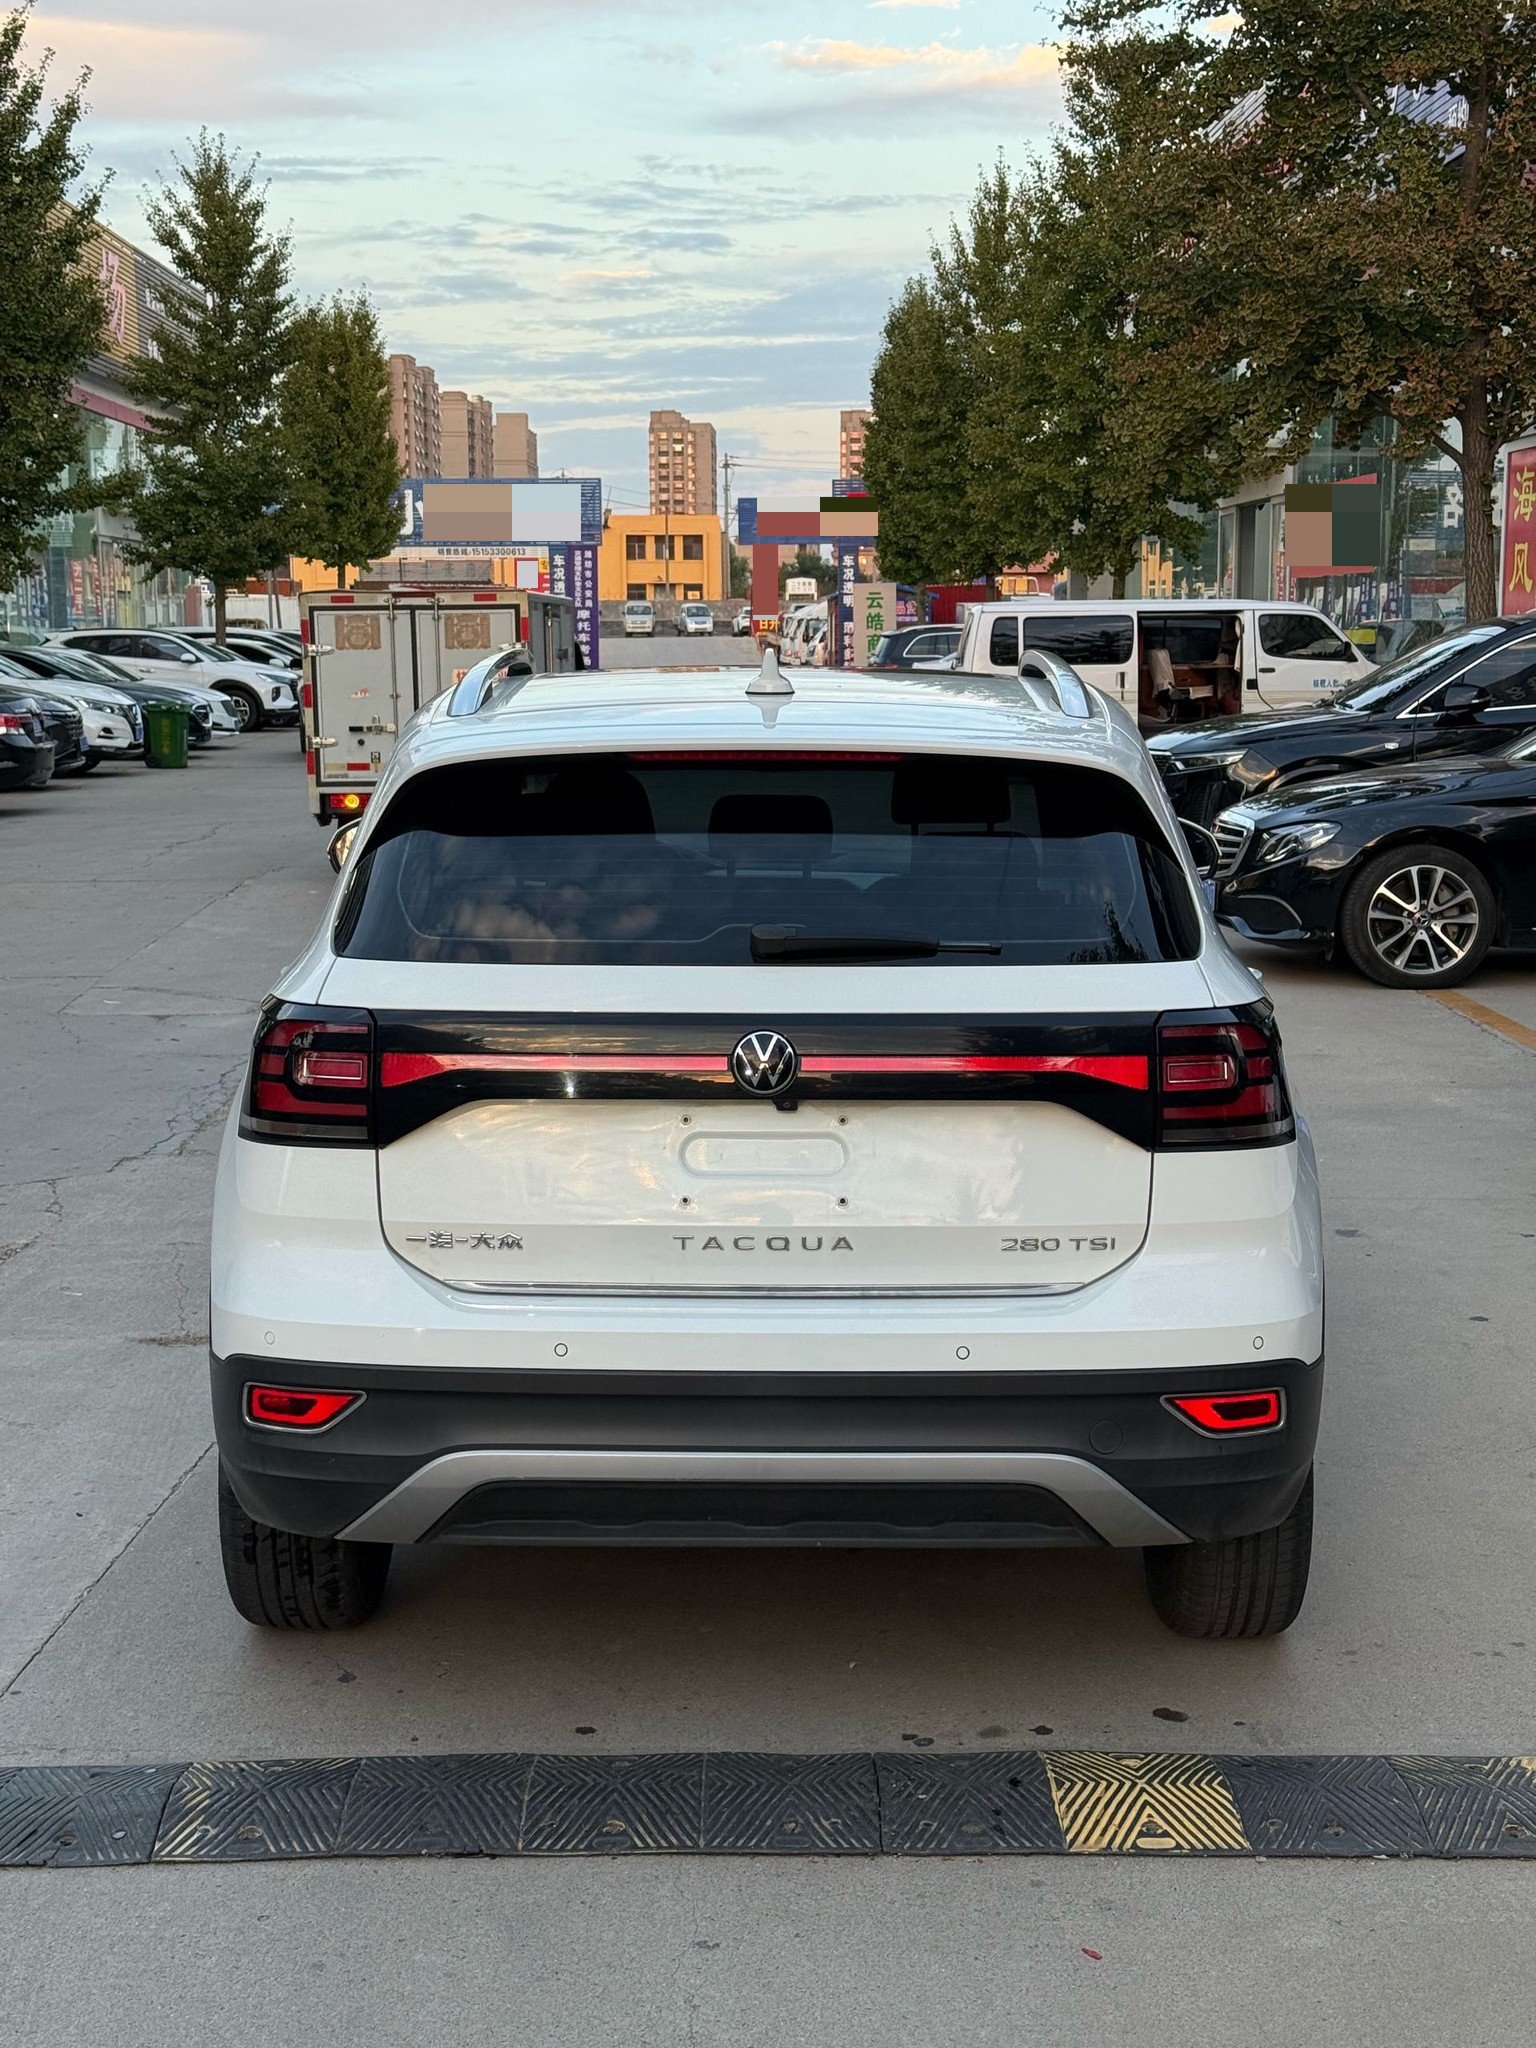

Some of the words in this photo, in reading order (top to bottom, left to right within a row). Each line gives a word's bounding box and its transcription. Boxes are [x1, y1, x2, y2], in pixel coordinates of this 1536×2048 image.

[1509, 466, 1536, 593] 海风
[553, 554, 566, 598] 车况透
[842, 555, 855, 608] 车况透明
[866, 592, 884, 667] 云皓商
[406, 1230, 523, 1249] 一汽-大众
[672, 1235, 854, 1251] TACQUA
[1001, 1237, 1061, 1251] 280
[1068, 1237, 1116, 1250] TSI
